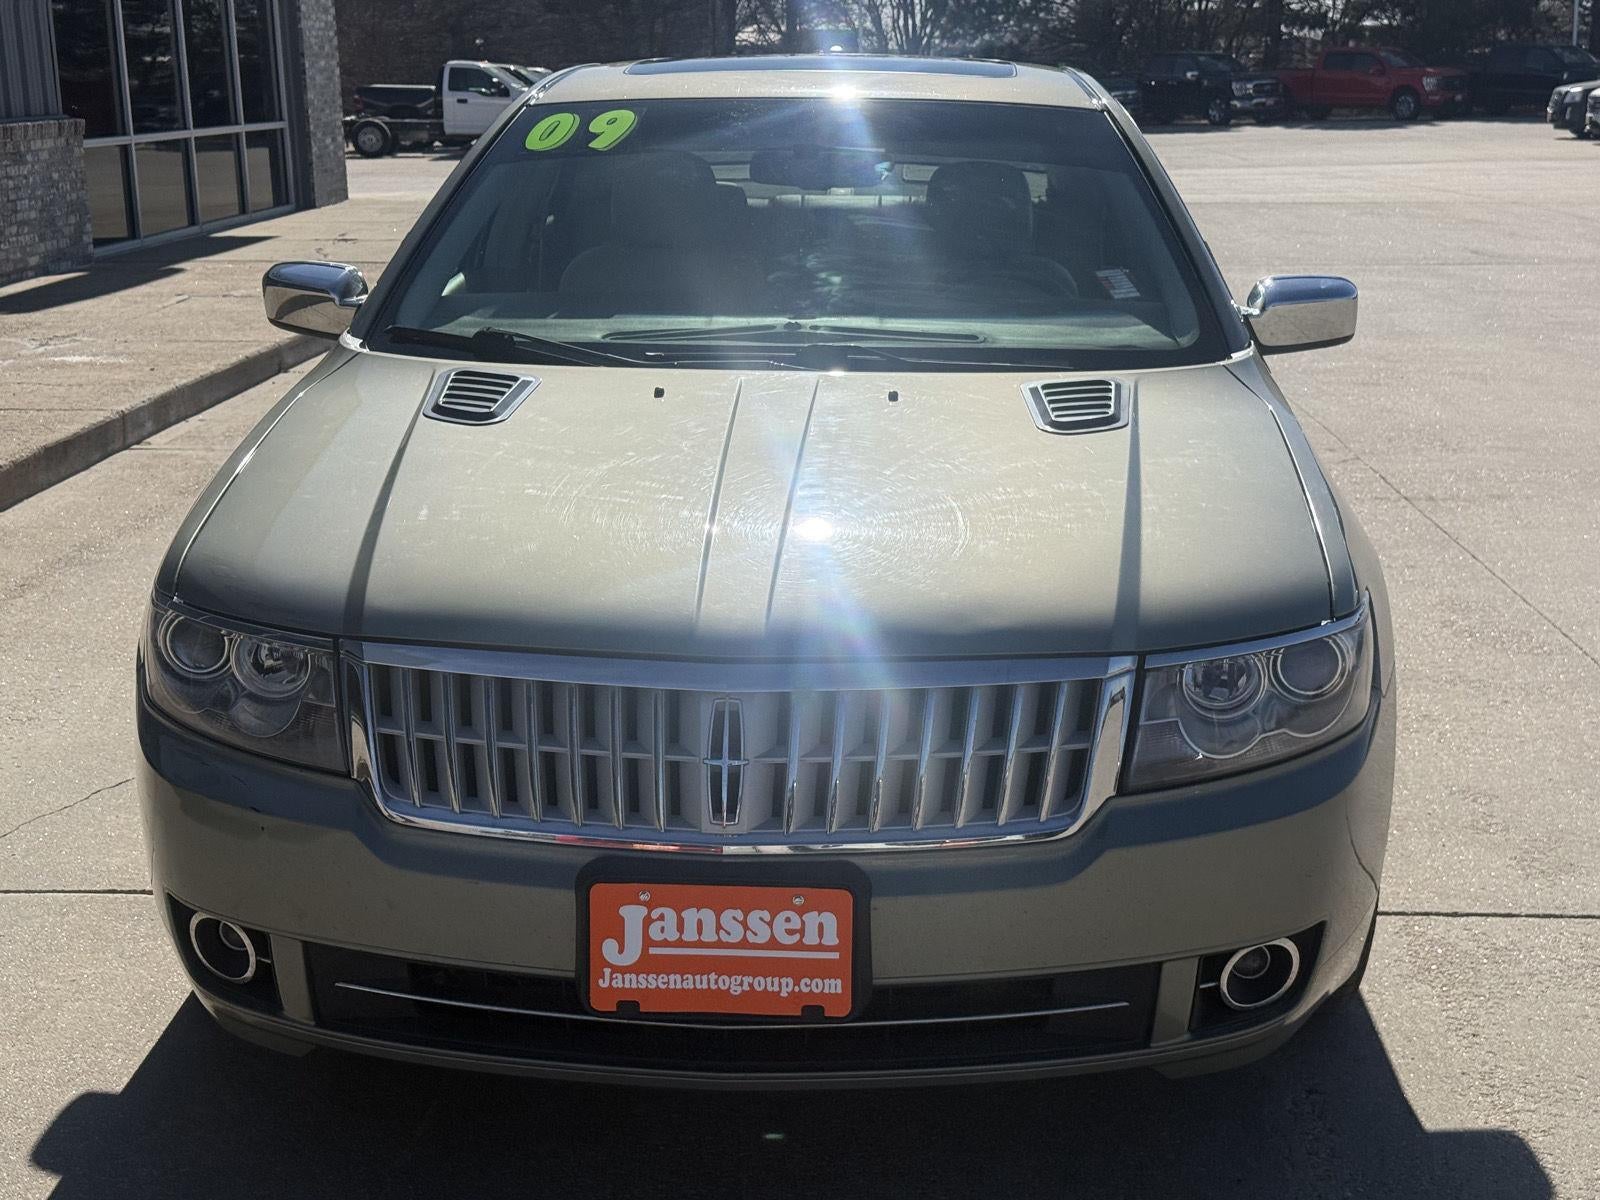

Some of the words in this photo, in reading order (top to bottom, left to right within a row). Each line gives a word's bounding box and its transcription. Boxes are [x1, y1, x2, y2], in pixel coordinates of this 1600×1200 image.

[525, 109, 638, 151] 09
[602, 904, 839, 967] Janssen
[598, 968, 842, 997] Janssenautogroup.com
